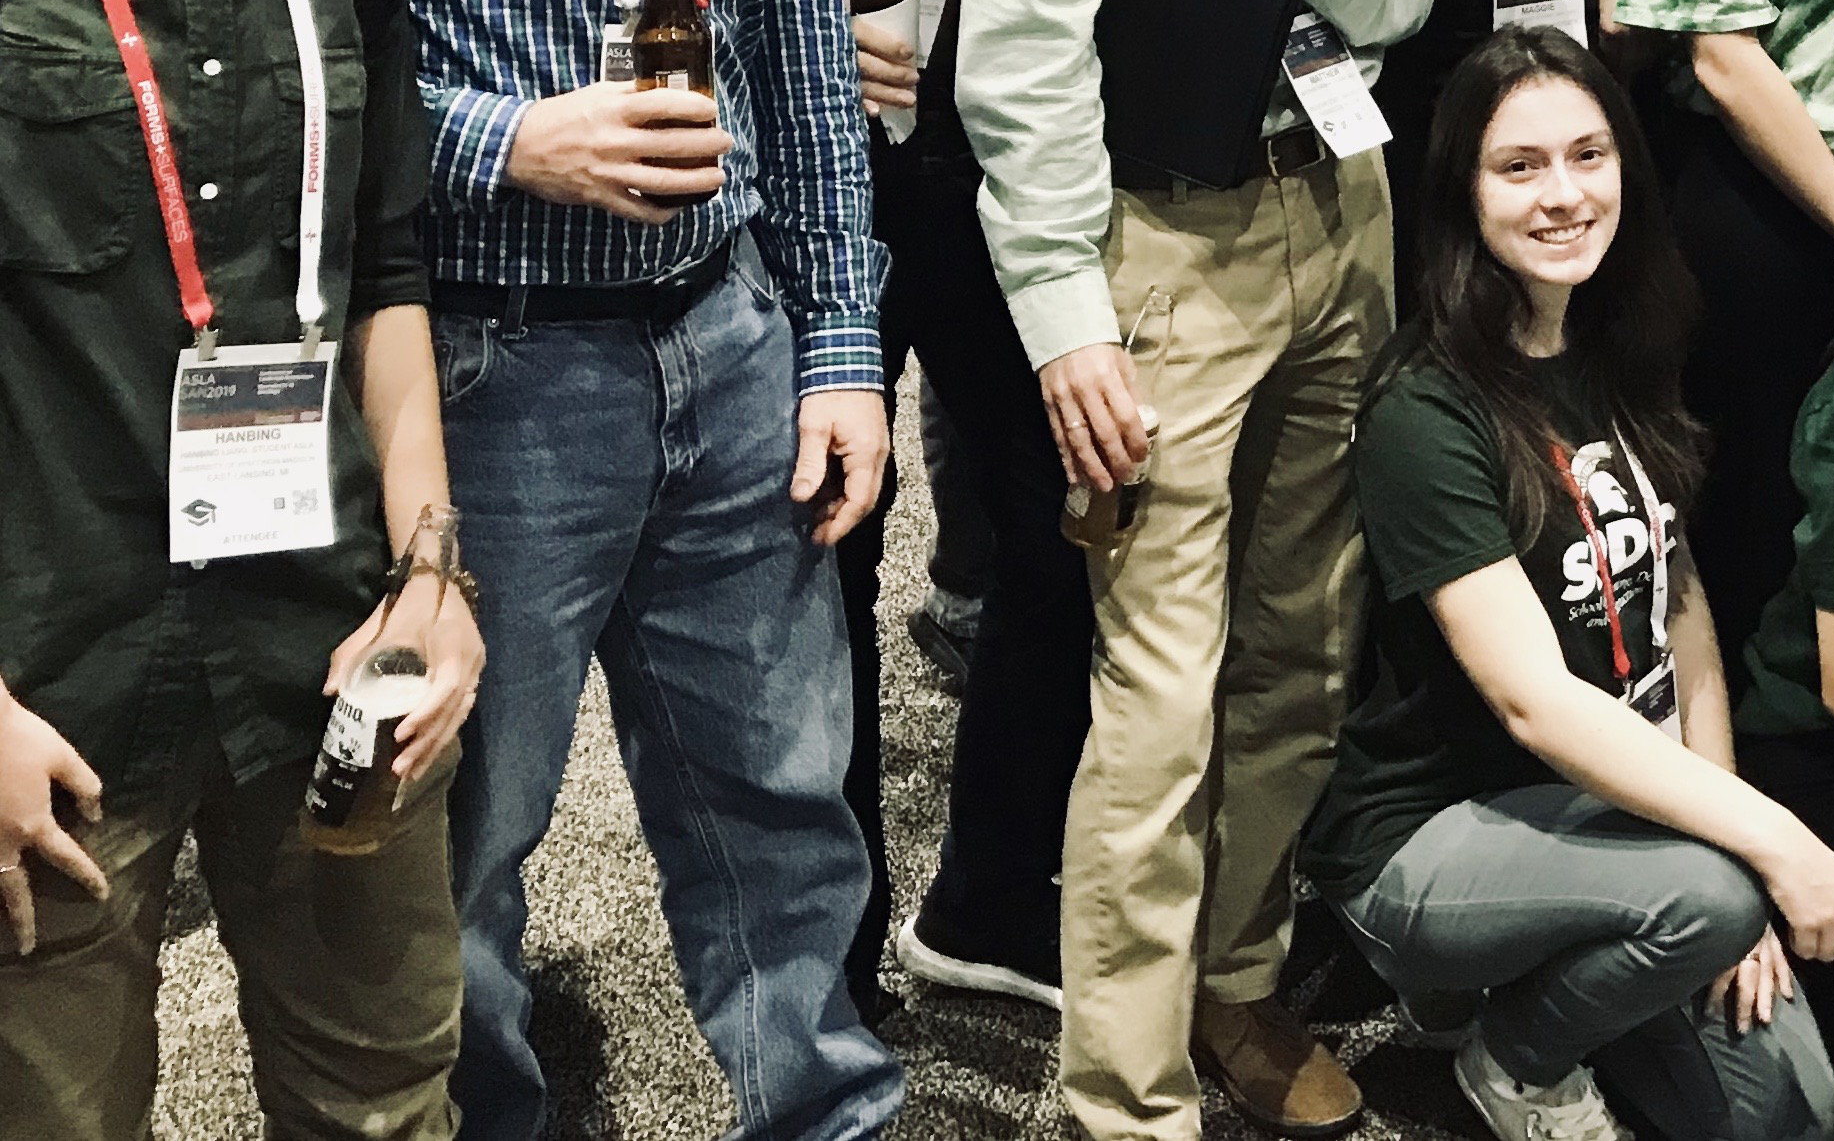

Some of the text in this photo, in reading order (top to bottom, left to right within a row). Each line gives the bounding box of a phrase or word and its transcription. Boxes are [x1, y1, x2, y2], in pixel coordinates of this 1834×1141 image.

[138, 80, 188, 244] FORMS+SURFACES
[182, 373, 216, 386] ASLA
[215, 428, 282, 445] HANBING
